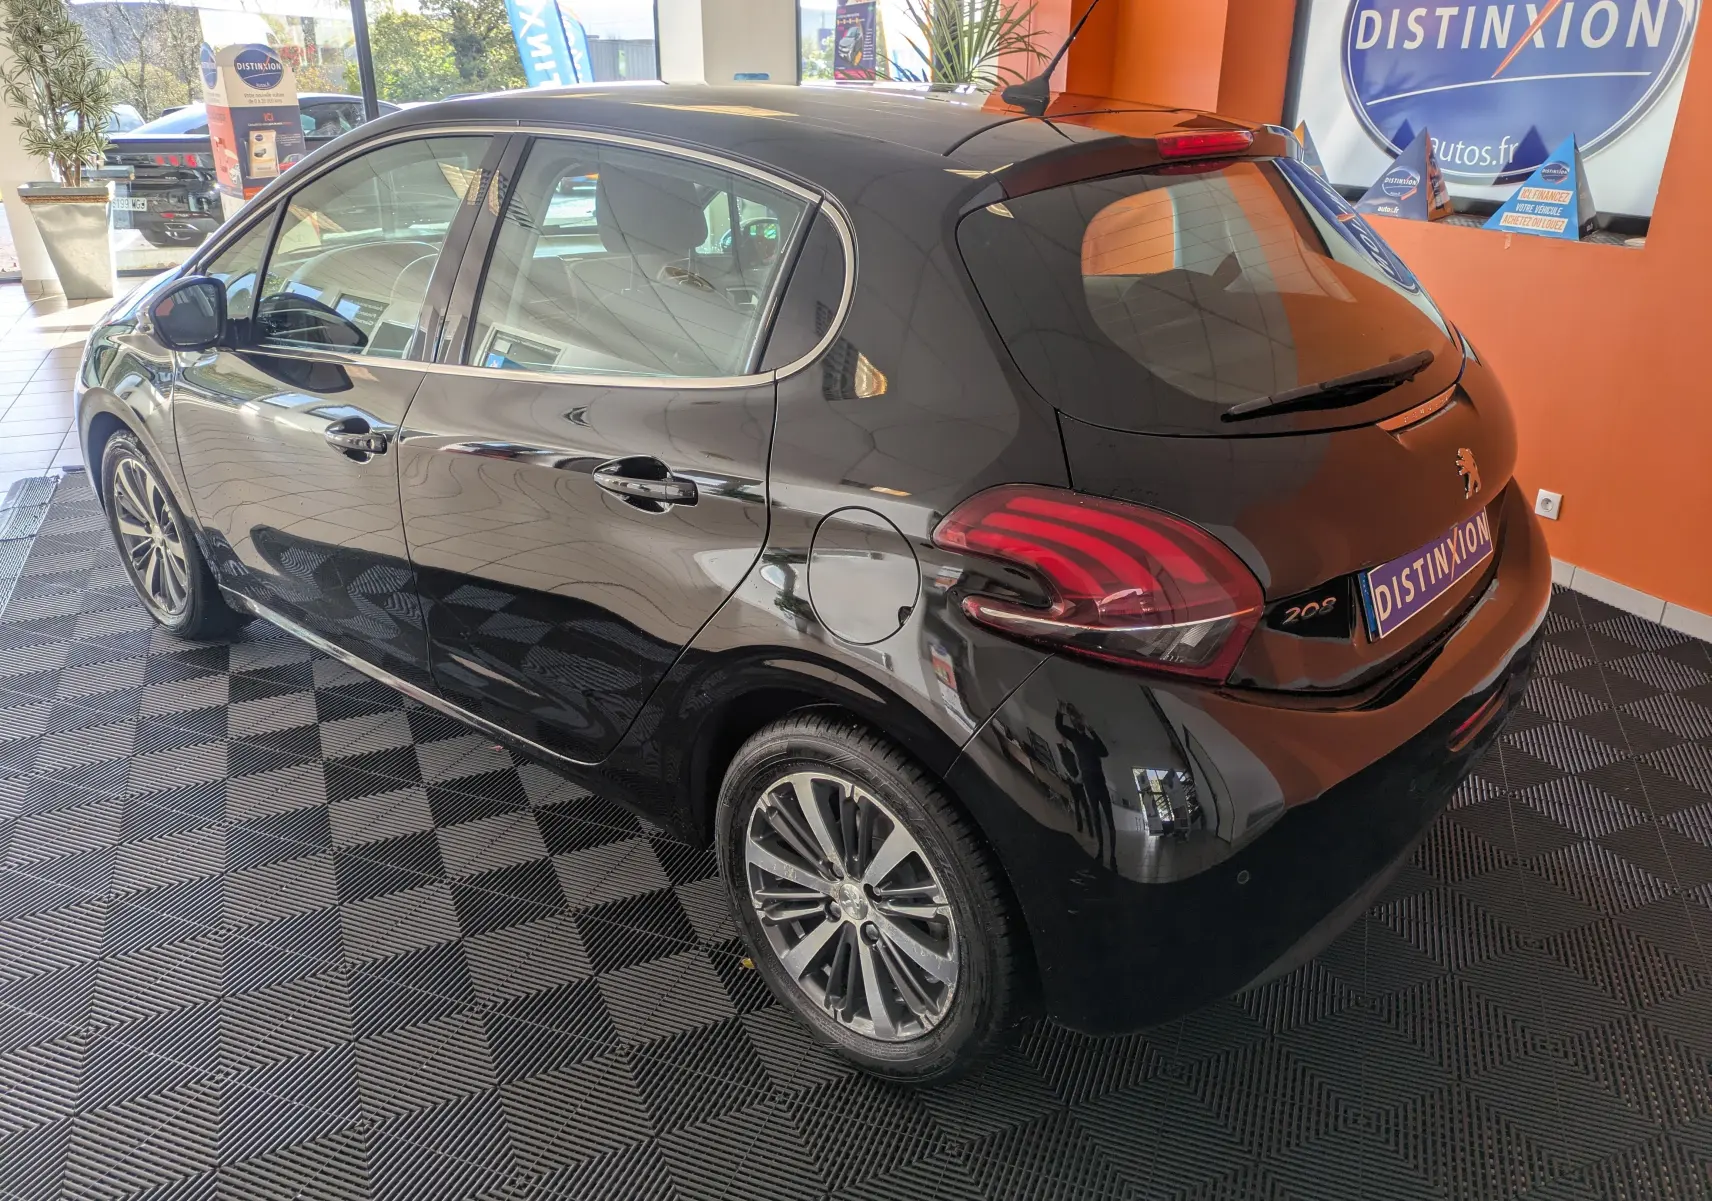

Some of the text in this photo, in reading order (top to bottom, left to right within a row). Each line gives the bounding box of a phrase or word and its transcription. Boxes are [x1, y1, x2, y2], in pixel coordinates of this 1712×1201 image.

[1355, 0, 1667, 50] DISTINXION
[236, 62, 282, 71] DISTINXION
[1384, 177, 1417, 185] DISTINXION
[1516, 203, 1563, 216] VOTRE VÉHICULE
[1502, 214, 1532, 227] ACHETEZ
[1542, 218, 1565, 231] LOUEZ
[1374, 511, 1490, 622] DISTINXION
[1282, 597, 1337, 625] 208
